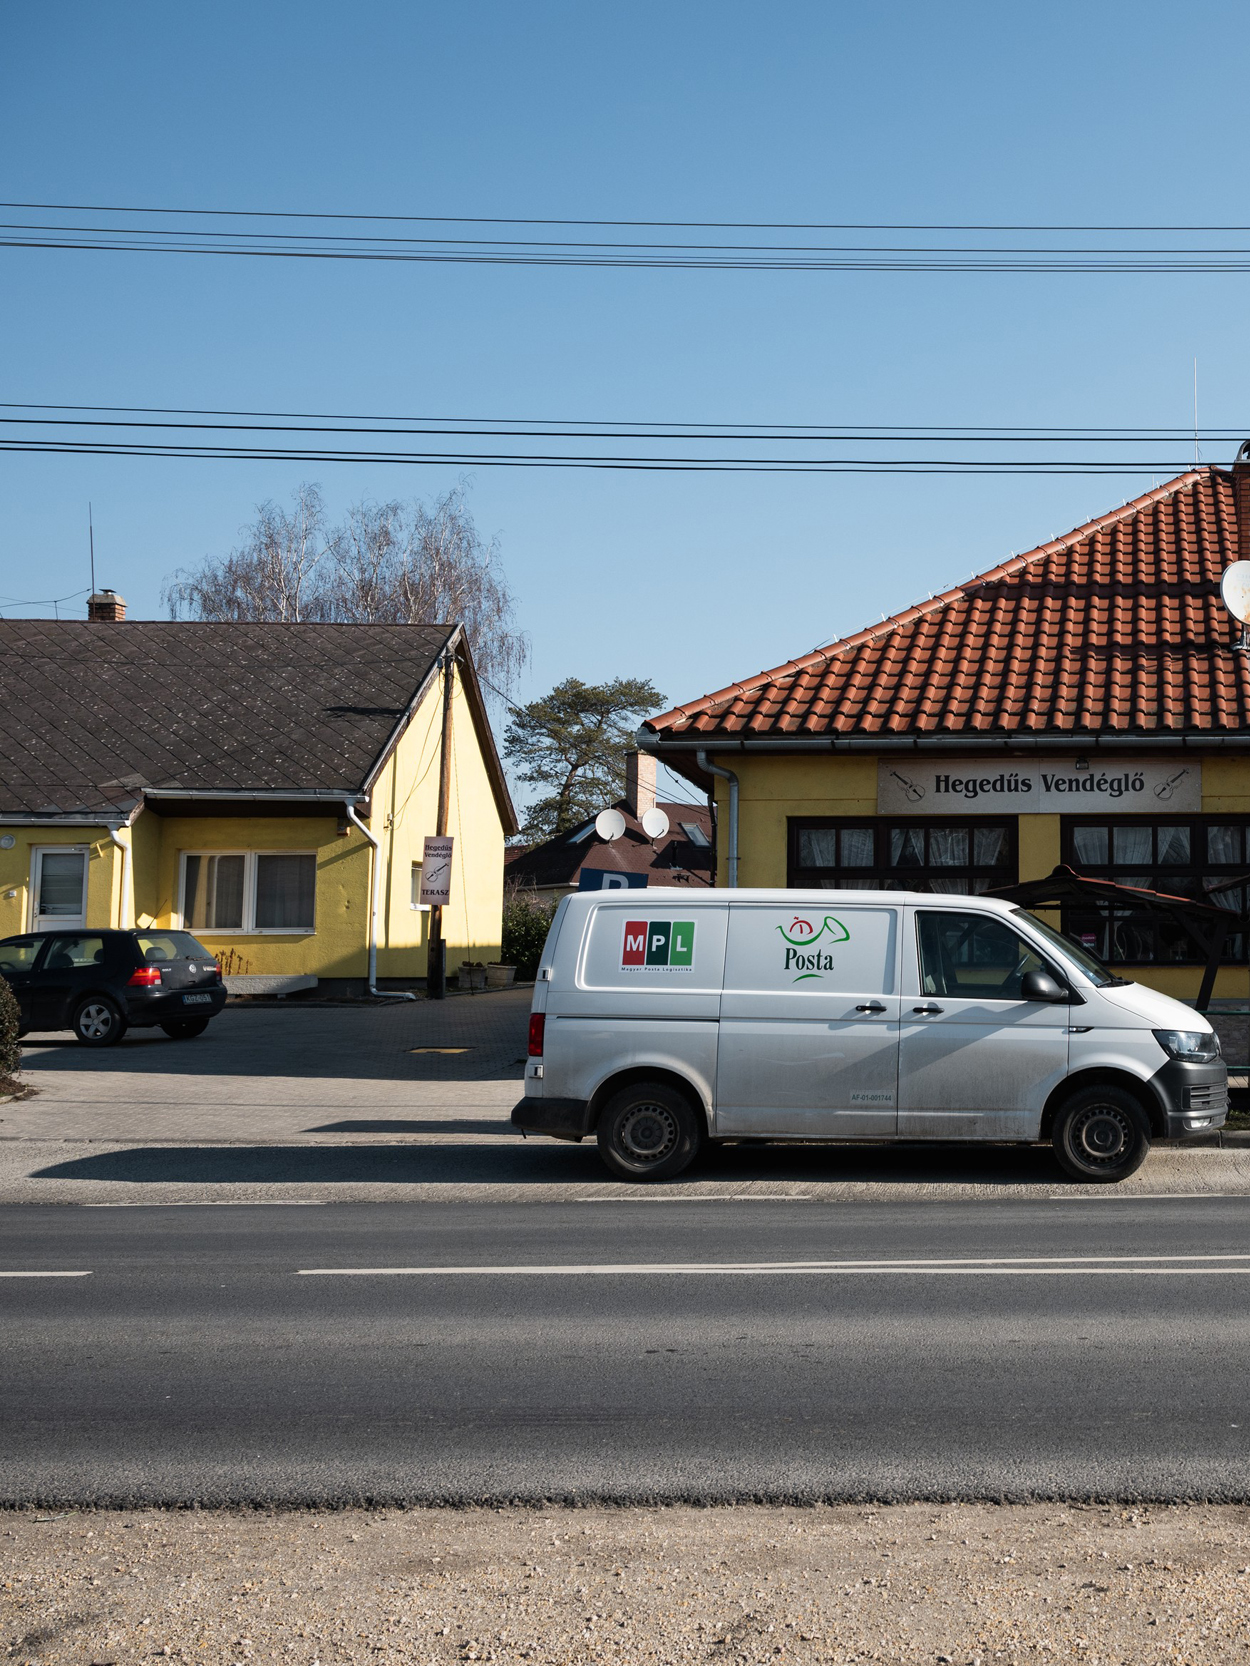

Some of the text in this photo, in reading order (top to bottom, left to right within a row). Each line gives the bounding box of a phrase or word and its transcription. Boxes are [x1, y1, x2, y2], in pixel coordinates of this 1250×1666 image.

[935, 772, 1145, 798] Hegedűs Vendéglő
[626, 935, 688, 952] MPL
[784, 947, 834, 971] Posta
